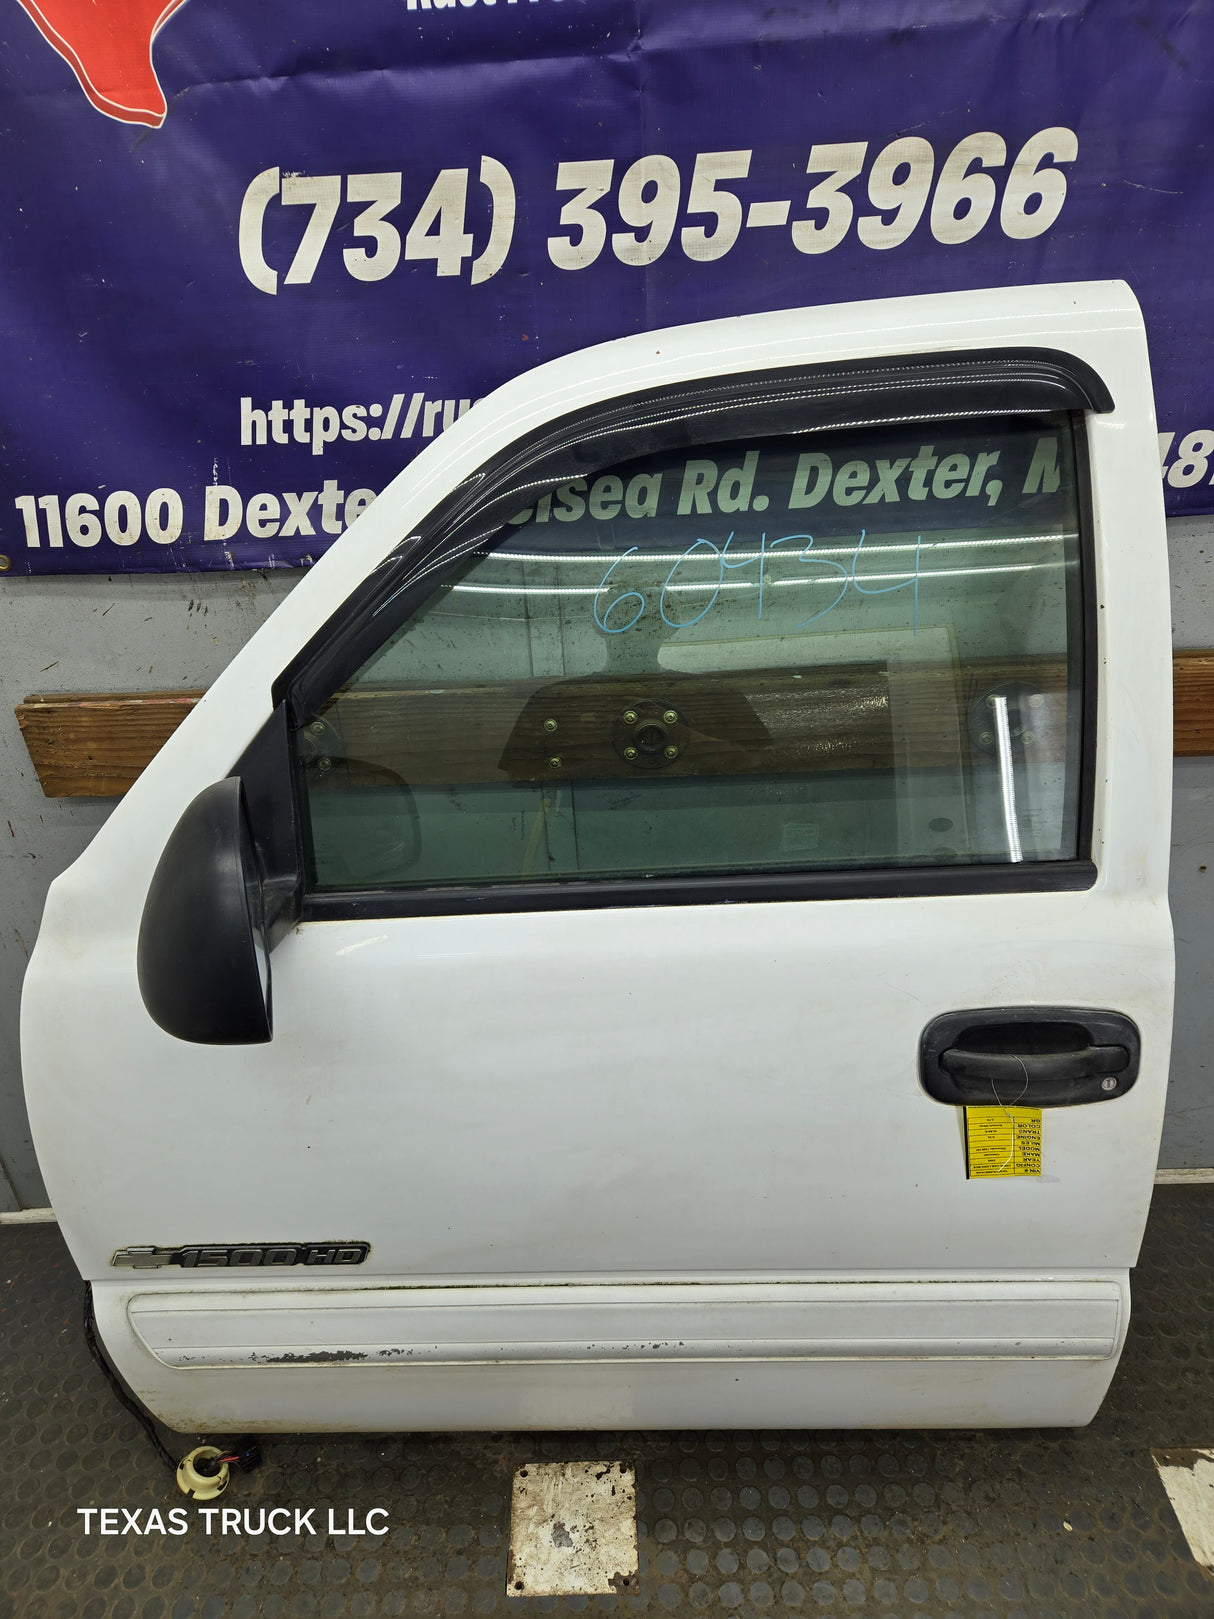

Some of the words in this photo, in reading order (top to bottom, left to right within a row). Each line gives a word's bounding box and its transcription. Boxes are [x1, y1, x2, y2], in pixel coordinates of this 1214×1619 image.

[238, 155, 516, 295] (734)
[547, 126, 1079, 271] 395-3966
[240, 392, 484, 456] https://ru
[15, 488, 184, 548] 11600
[203, 480, 380, 542] Dexte
[677, 450, 770, 515] Rd.
[788, 445, 1003, 507] Dexter,
[594, 529, 922, 636] 60434
[181, 1250, 297, 1268] 1500
[307, 1249, 362, 1264] HD
